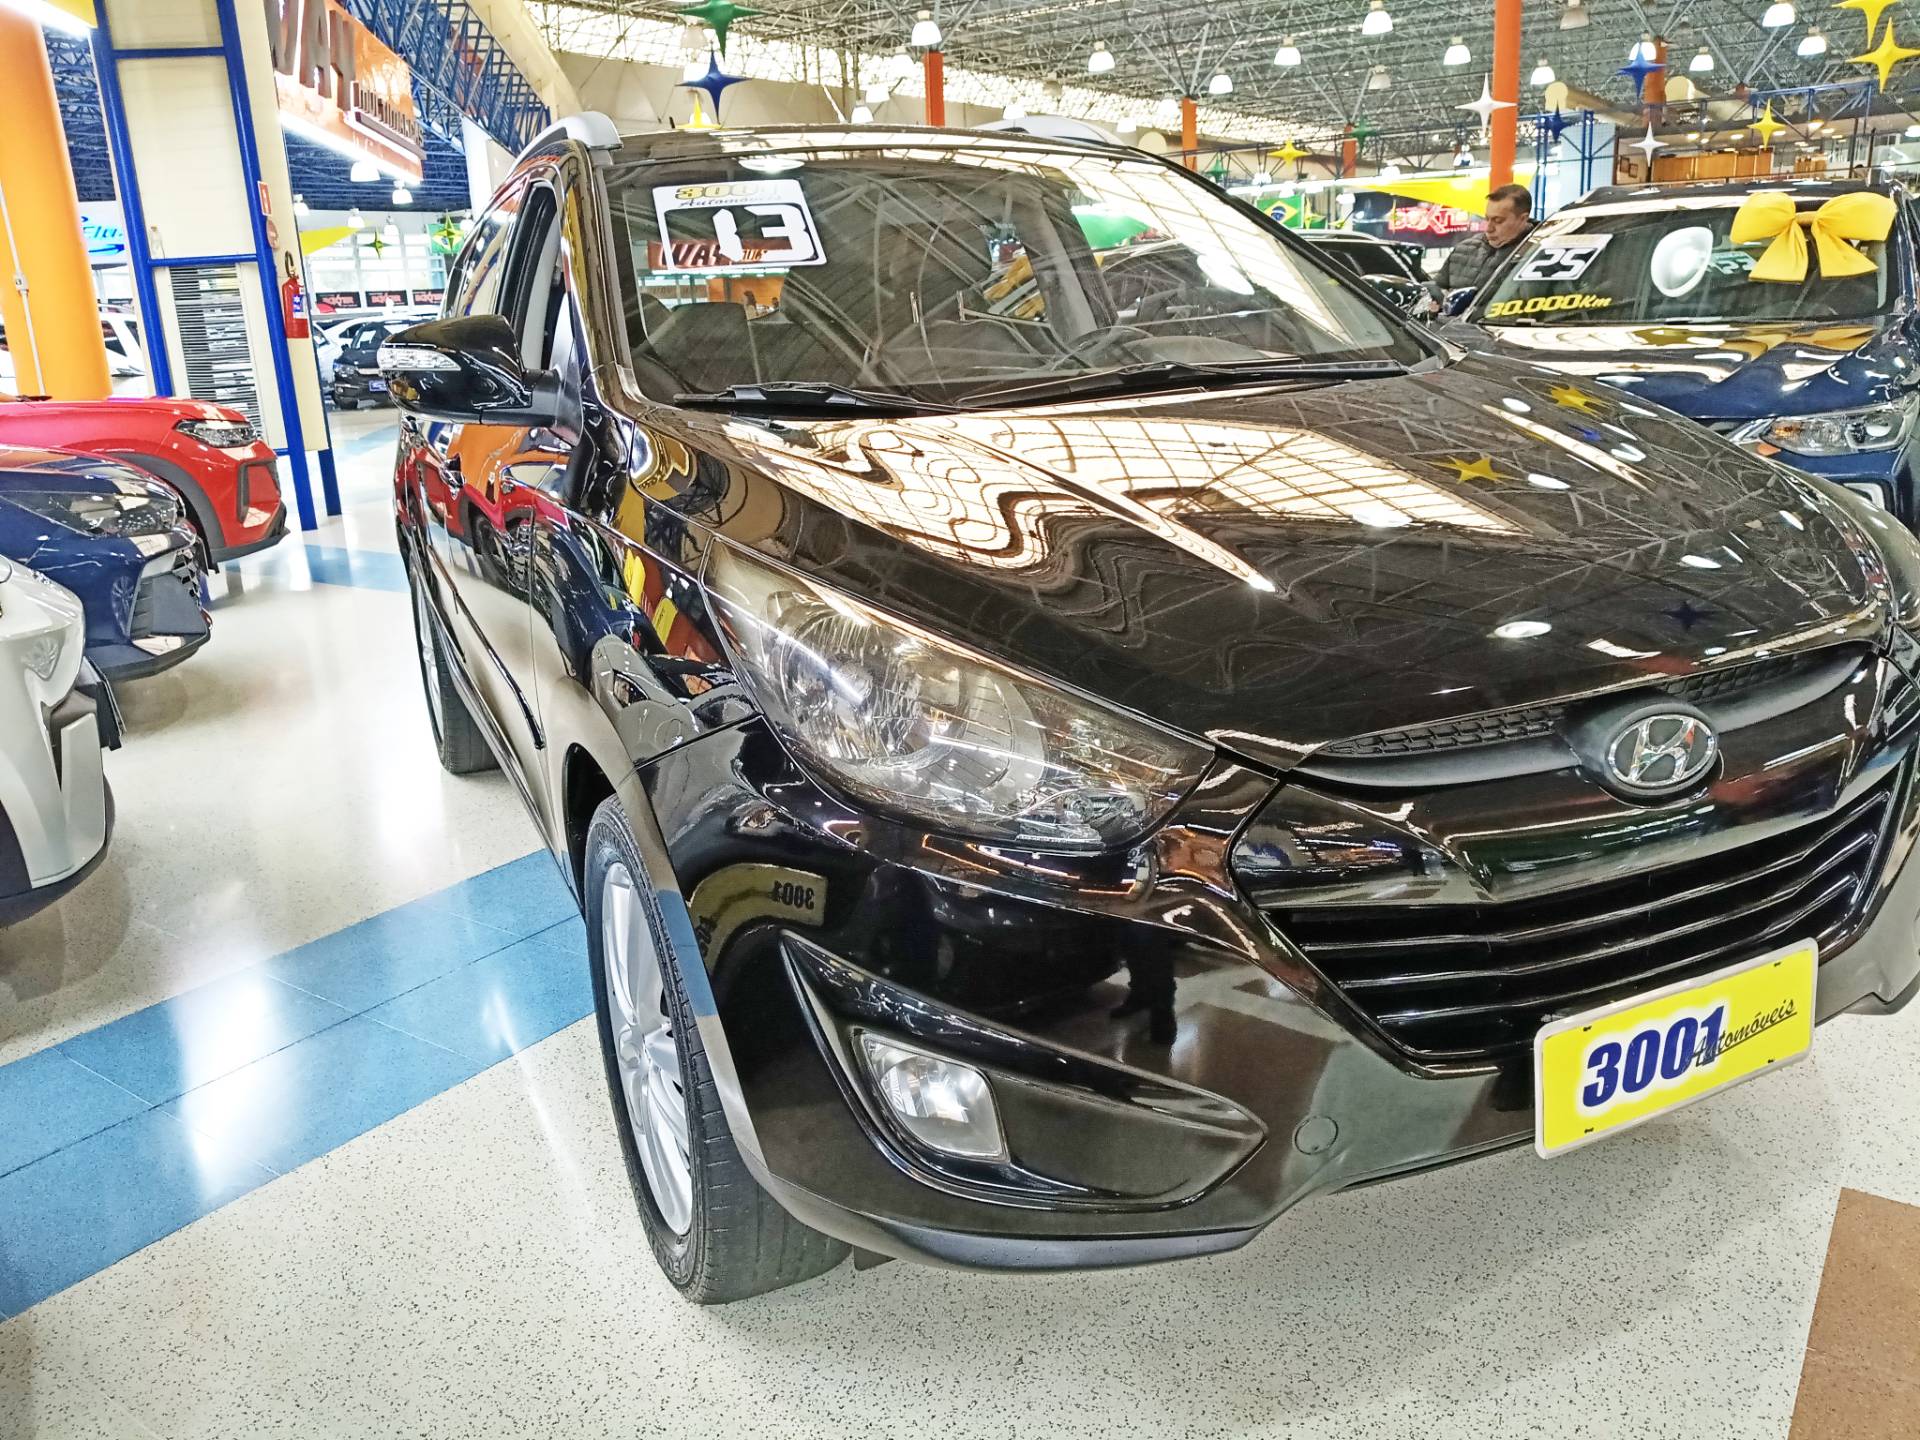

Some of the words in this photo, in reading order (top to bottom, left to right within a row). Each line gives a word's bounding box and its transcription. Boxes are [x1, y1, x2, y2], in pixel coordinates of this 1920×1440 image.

[711, 204, 816, 263] 13
[1519, 248, 1597, 278] 25
[1484, 294, 1612, 318] 30.000Km
[1582, 1005, 1725, 1107] 3001
[1685, 998, 1798, 1069] Automóveis
